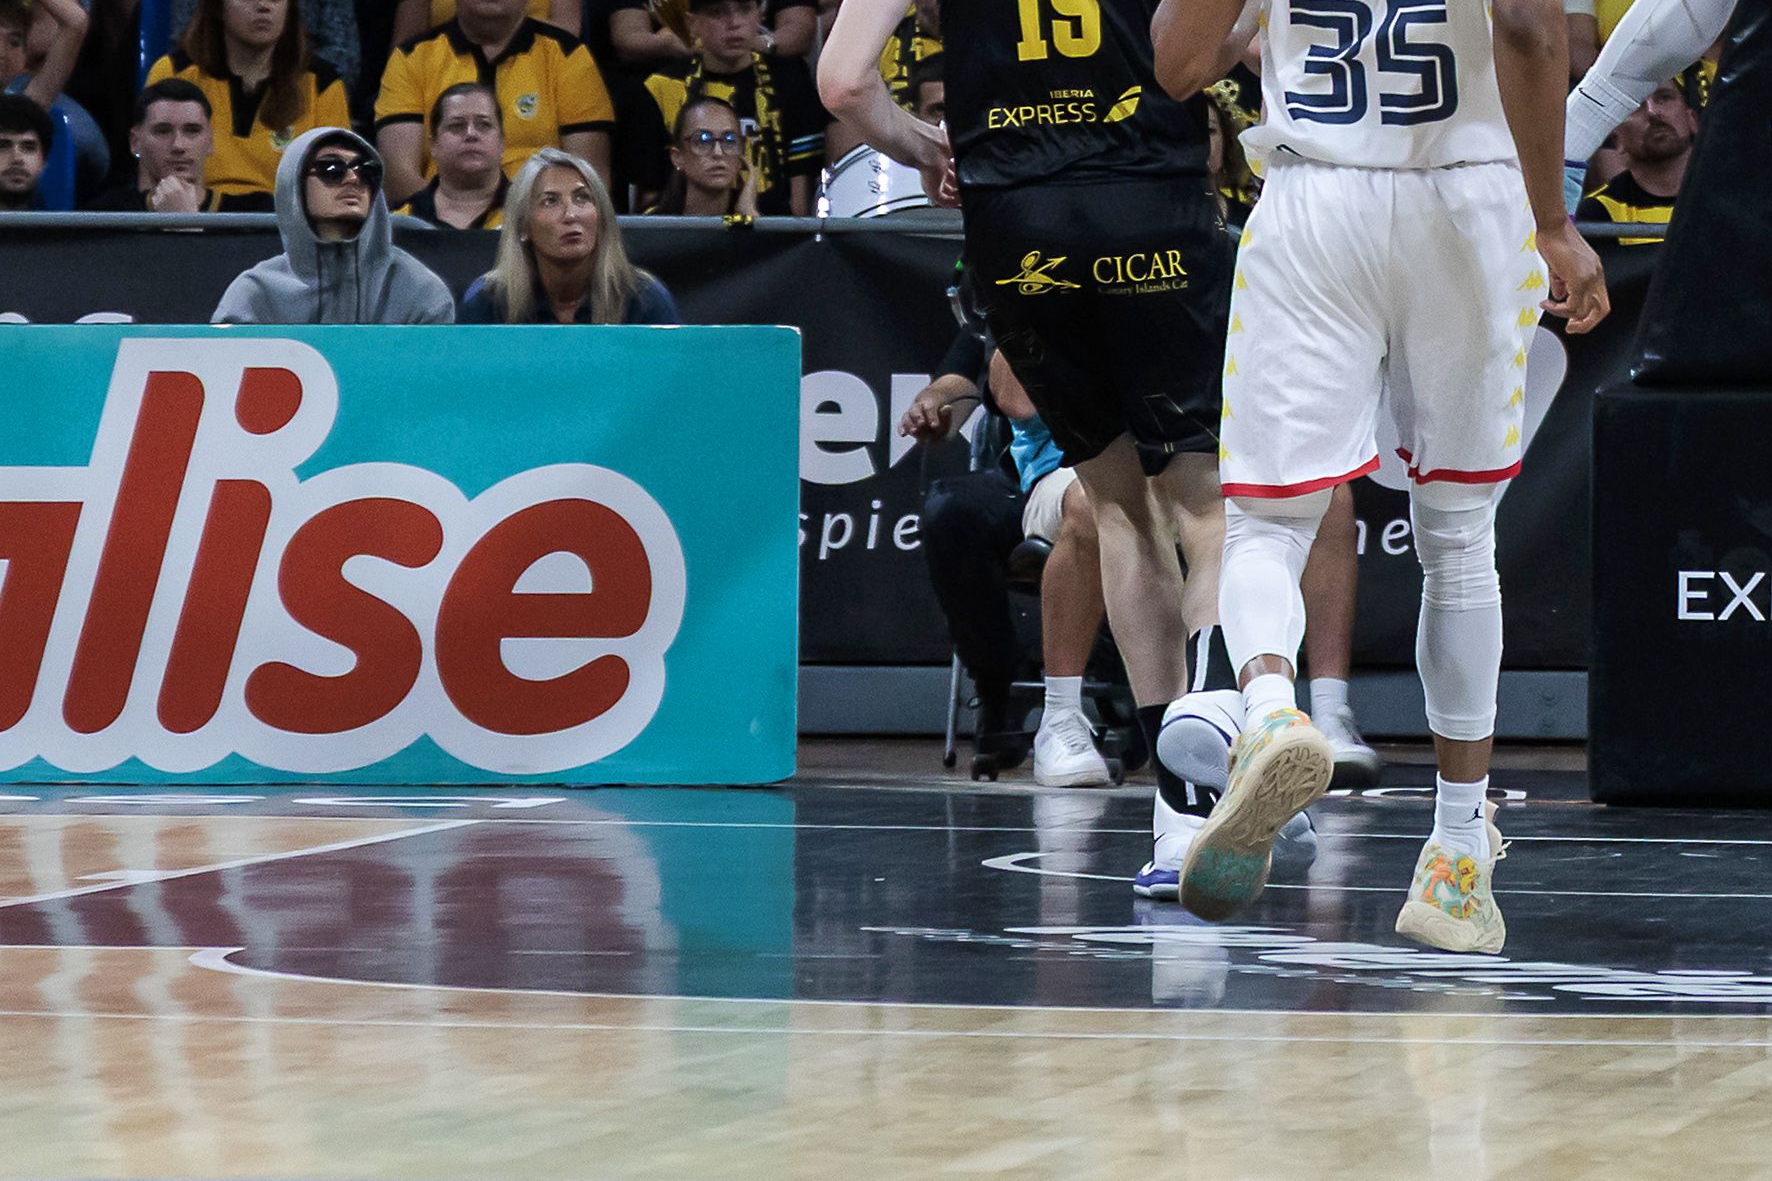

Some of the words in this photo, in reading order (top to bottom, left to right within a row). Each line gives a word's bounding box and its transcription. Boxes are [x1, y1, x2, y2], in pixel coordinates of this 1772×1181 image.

[1050, 89, 1095, 99] IBERIA
[988, 102, 1097, 129] EXPRESS
[1093, 250, 1188, 284] CICAR
